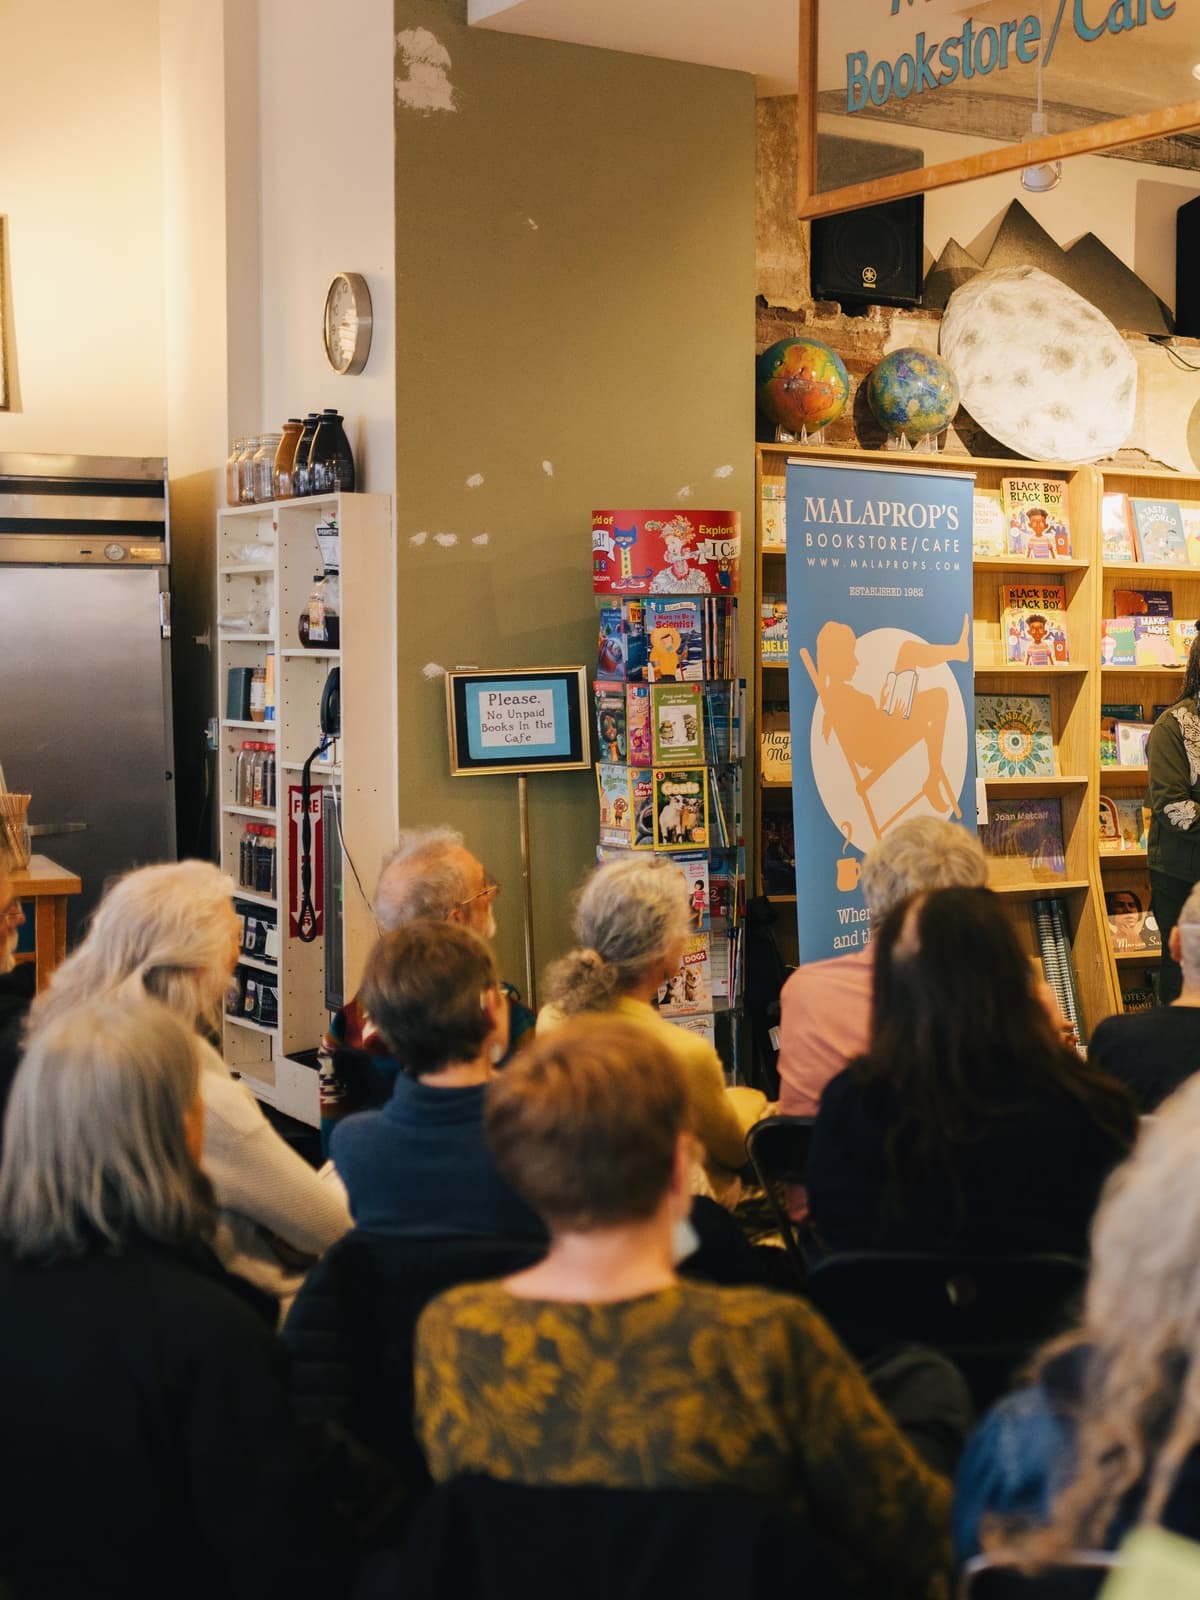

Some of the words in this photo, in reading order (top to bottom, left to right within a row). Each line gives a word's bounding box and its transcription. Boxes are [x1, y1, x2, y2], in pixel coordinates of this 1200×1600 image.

[1009, 481, 1041, 492] BLACK
[1010, 492, 1041, 502] BLACK
[1043, 493, 1062, 503] BOY
[803, 496, 960, 531] MALAPROP'S
[805, 533, 961, 554] BOOKSTORE/CAFE
[806, 557, 961, 571] WWW.MALAPROPS.COM
[849, 586, 902, 597] ESTABLISHED
[1009, 588, 1040, 599] BLACK
[655, 621, 694, 629] Scientist
[488, 693, 541, 706] Please.
[487, 711, 503, 720] No
[507, 709, 545, 721] Unpaid
[482, 723, 514, 733] Books
[535, 719, 553, 729] the
[504, 733, 532, 744] Cafe
[662, 783, 699, 794] Goats
[833, 932, 859, 949] and
[684, 951, 706, 964] DOGS
